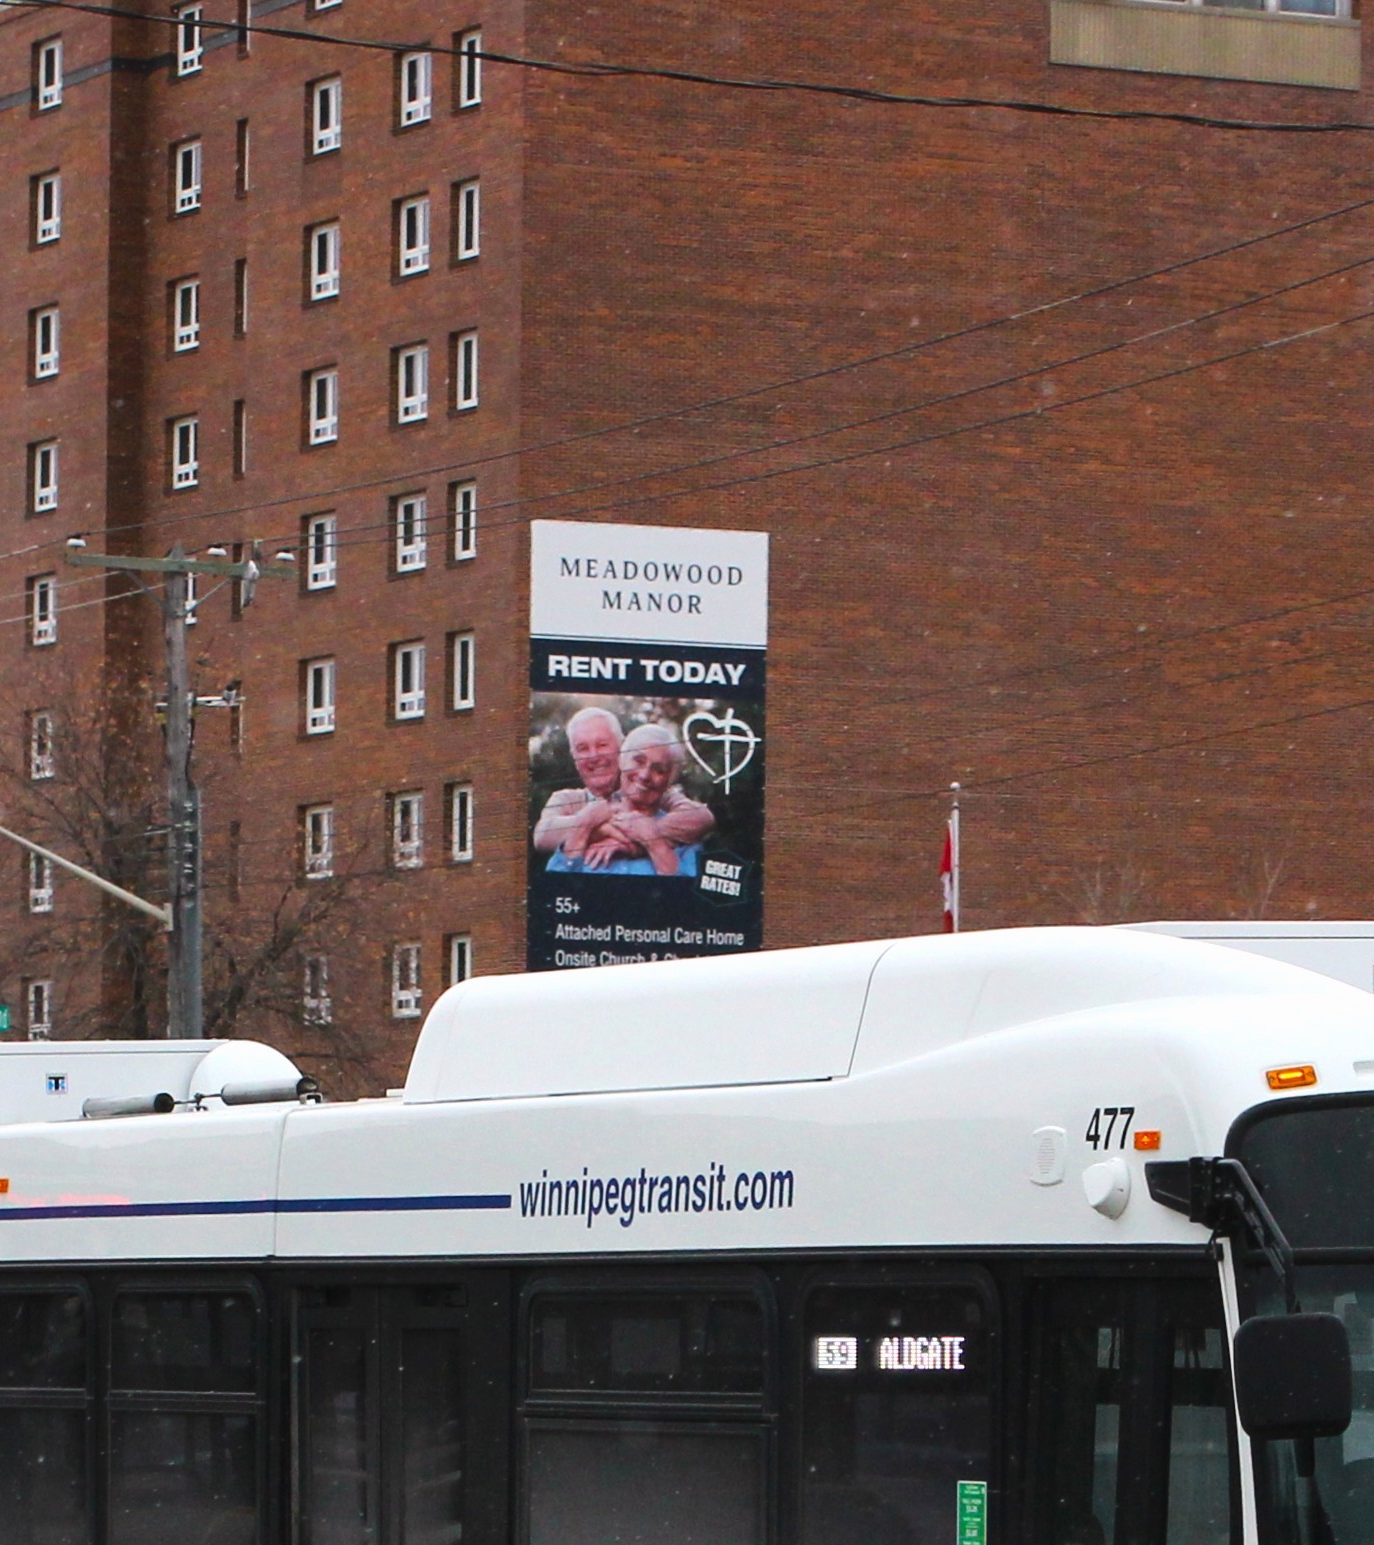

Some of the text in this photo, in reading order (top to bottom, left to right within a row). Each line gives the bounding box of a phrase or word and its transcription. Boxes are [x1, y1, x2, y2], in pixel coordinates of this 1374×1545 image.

[560, 557, 743, 586] MEADOWOOD
[601, 590, 702, 614] MANOR
[548, 654, 746, 685] RENT TODAY
[705, 860, 742, 880] GREAT
[700, 875, 741, 896] RATES!
[555, 898, 580, 913] 55+
[555, 923, 744, 946] Attached Personal Care Home
[555, 949, 596, 967] Onsite
[1085, 1106, 1135, 1151] 477
[520, 1161, 794, 1229] winnipegtransit.com
[823, 1337, 965, 1369] 59 ALDGATE
